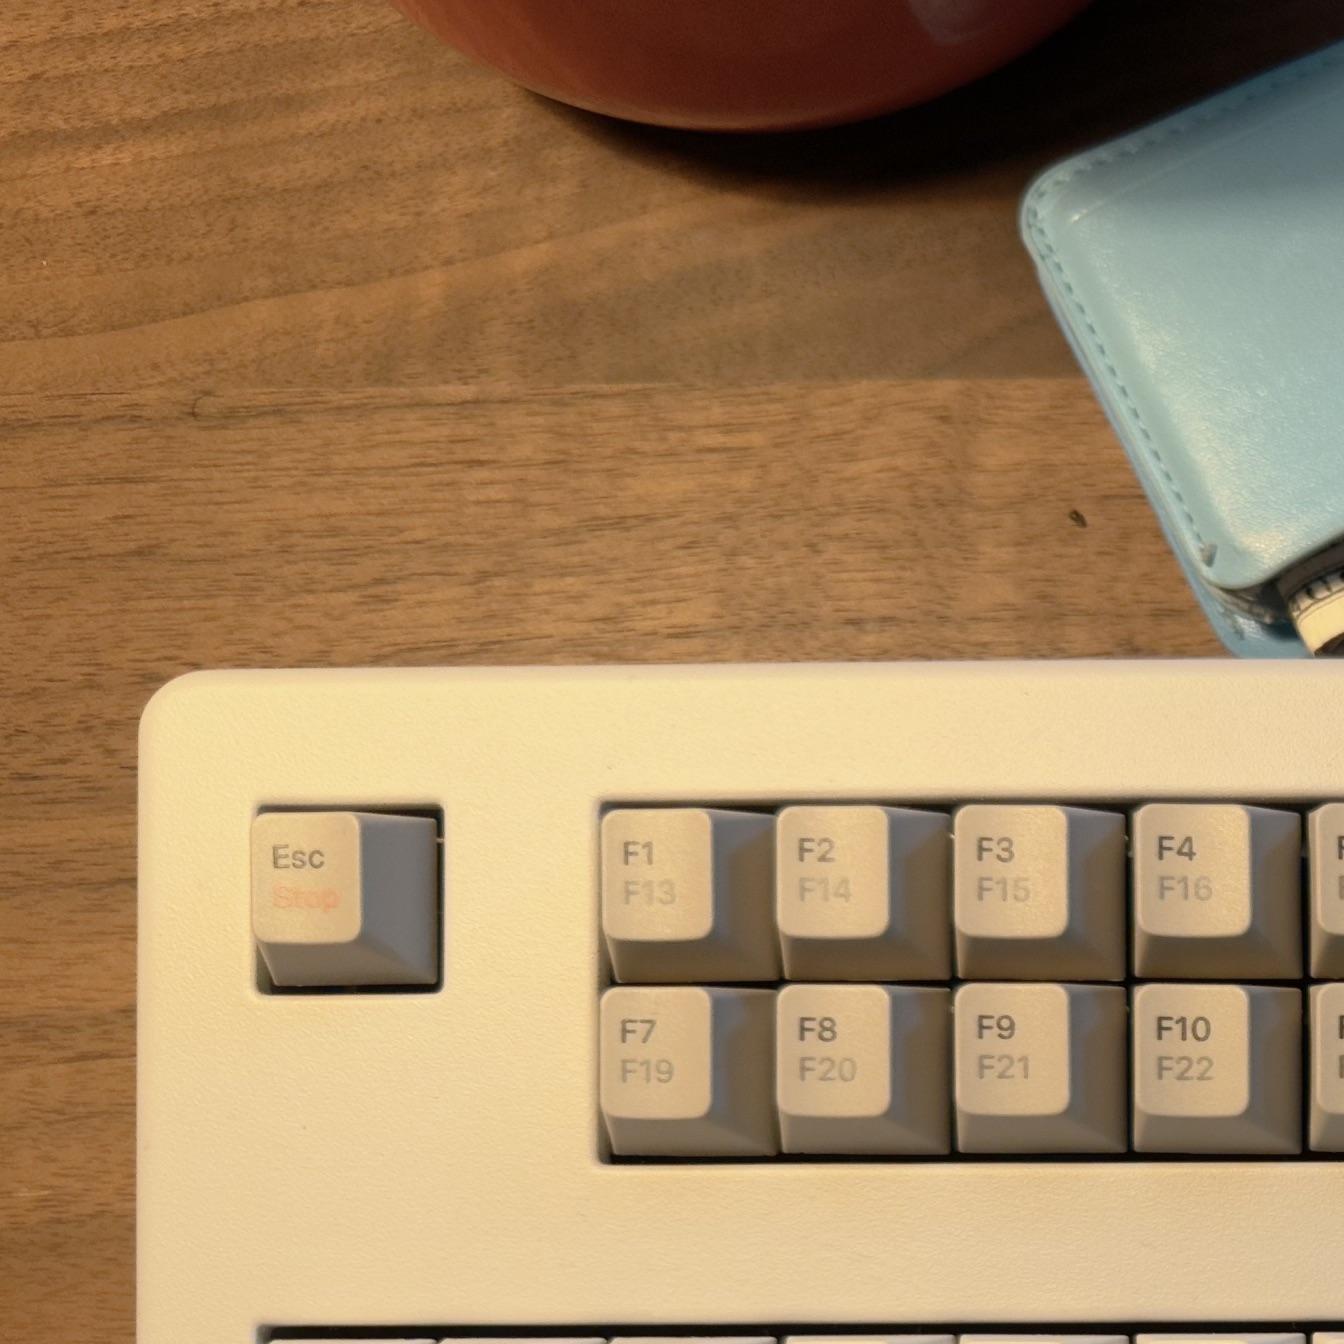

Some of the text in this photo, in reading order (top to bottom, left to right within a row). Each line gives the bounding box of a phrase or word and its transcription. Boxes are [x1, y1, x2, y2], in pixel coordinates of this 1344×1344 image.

[272, 844, 324, 869] Esc
[623, 841, 653, 866] F1
[798, 837, 835, 863] F2
[977, 837, 1014, 863] F3
[1158, 835, 1196, 861] F4
[272, 884, 341, 910] Stop
[621, 879, 677, 905] F13
[798, 877, 853, 903] F14
[976, 876, 1030, 902] F15
[1158, 875, 1213, 901] F16
[620, 1019, 656, 1044] F7
[799, 1017, 837, 1042] F8
[977, 1014, 1015, 1040] F9
[1156, 1016, 1211, 1042] F10
[620, 1058, 674, 1084] F19
[798, 1056, 857, 1082] F20
[977, 1054, 1029, 1079] F21
[1156, 1055, 1214, 1081] F22
